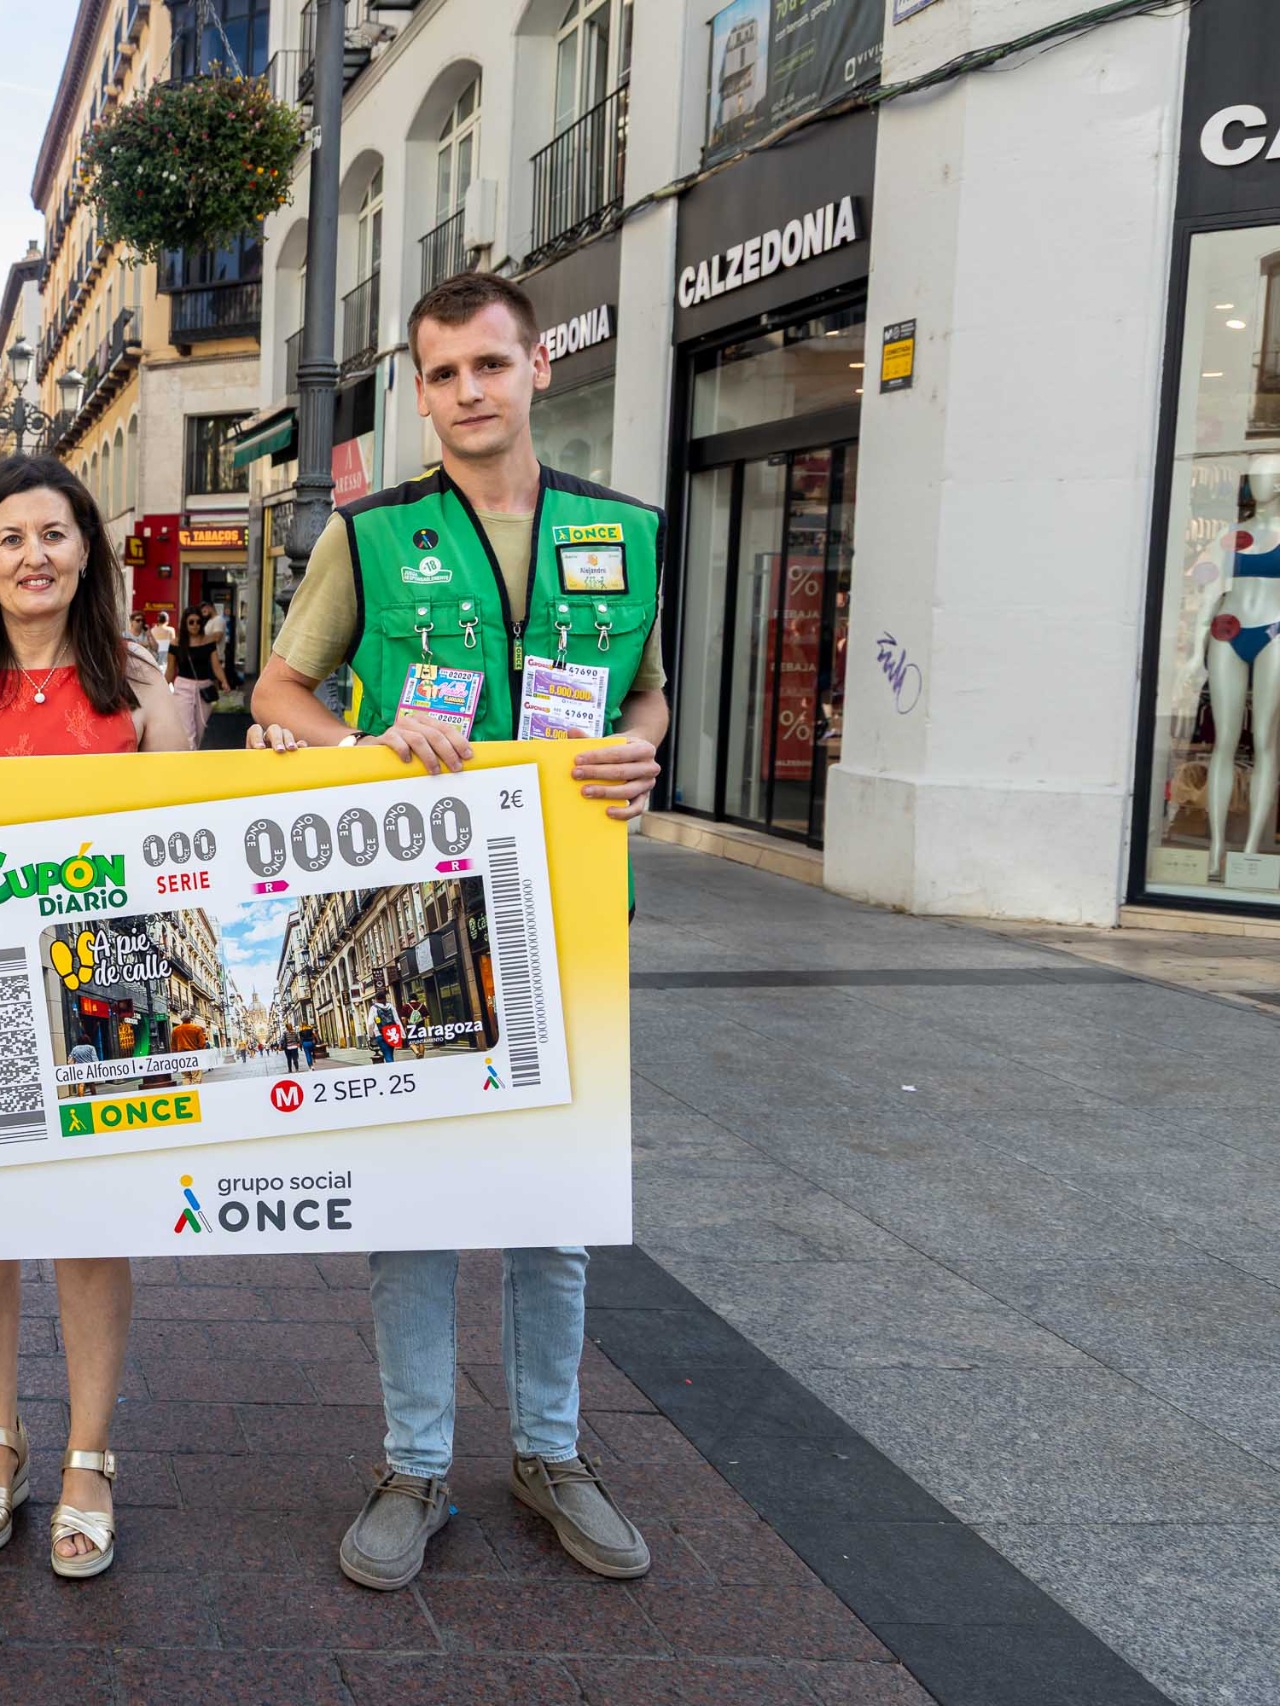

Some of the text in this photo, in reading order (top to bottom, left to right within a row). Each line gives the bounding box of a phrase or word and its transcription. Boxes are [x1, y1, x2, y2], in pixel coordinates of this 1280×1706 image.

[678, 195, 856, 309] CALZEDONIA
[193, 530, 239, 541] TABACOS
[573, 527, 618, 540] ONCE
[448, 671, 472, 680] 02020
[568, 666, 598, 676] 47690
[437, 714, 463, 724] 02020
[564, 709, 594, 720] 47690
[499, 789, 525, 810] 2€
[142, 828, 217, 868] 000
[244, 796, 473, 878] 00000
[156, 871, 211, 894] SERIE
[88, 927, 151, 966] A pie
[95, 954, 173, 987] de calle
[406, 1020, 483, 1040] Zaragoza
[55, 1065, 83, 1083] Calle
[86, 1062, 130, 1079] Alfonso
[146, 1055, 199, 1074] Zaragoza
[275, 1073, 416, 1108] M 2 SEP. 25
[100, 1096, 193, 1127] ONCE
[217, 1170, 352, 1196] grupo social
[218, 1198, 352, 1233] ONCE
